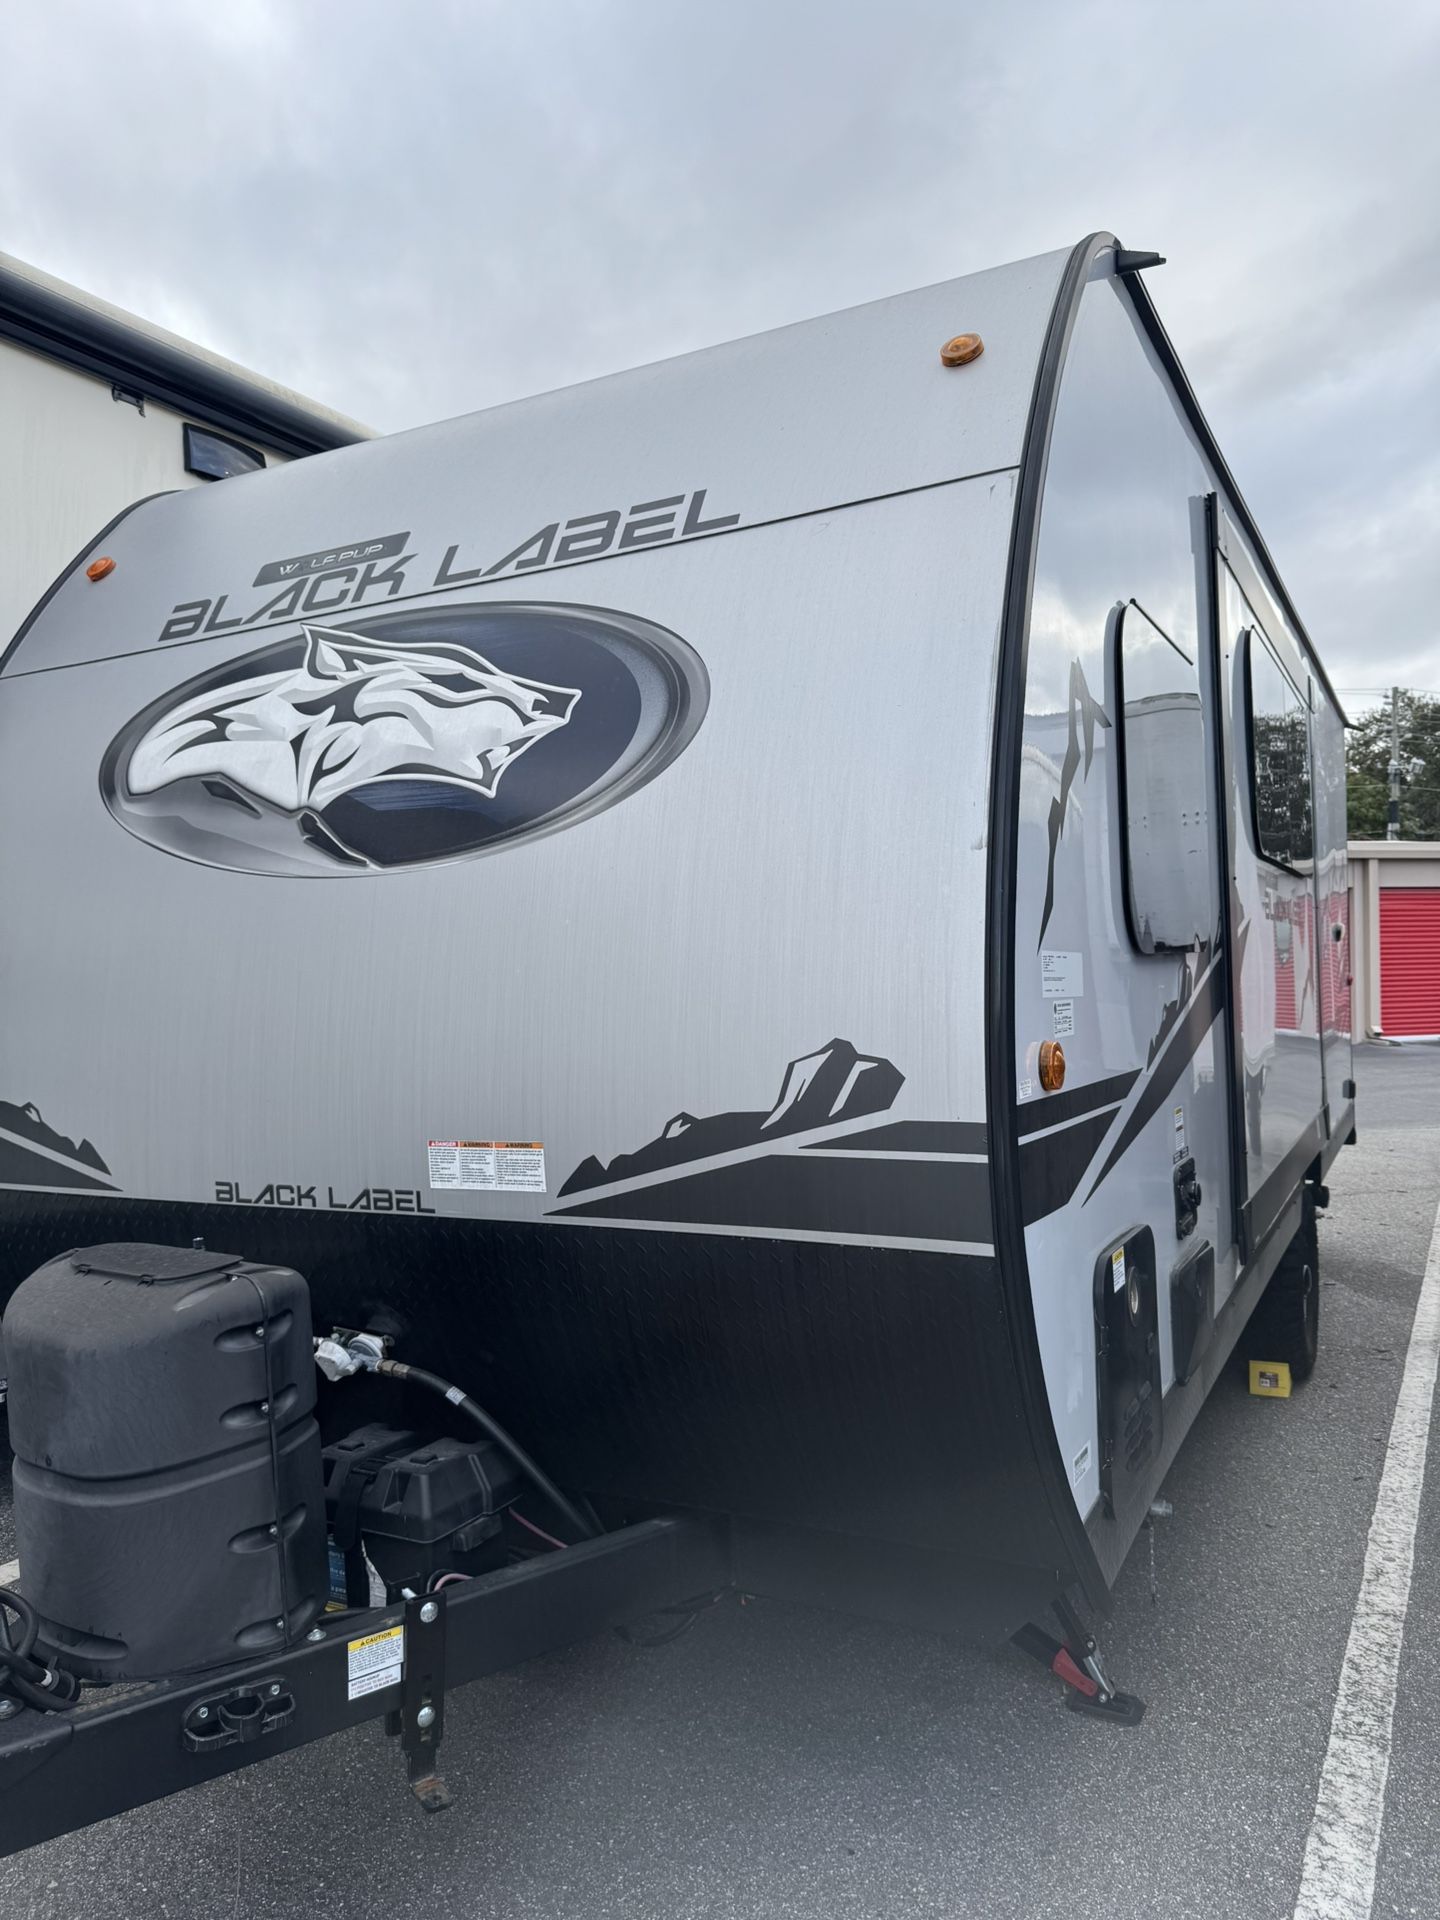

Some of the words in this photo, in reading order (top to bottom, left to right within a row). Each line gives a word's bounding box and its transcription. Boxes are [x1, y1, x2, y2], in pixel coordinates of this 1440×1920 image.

[158, 554, 417, 643] BLACK
[433, 489, 741, 587] LABEL
[215, 1181, 317, 1208] BLACK
[328, 1186, 436, 1214] LABEL
[365, 1632, 392, 1644] CAUTION
